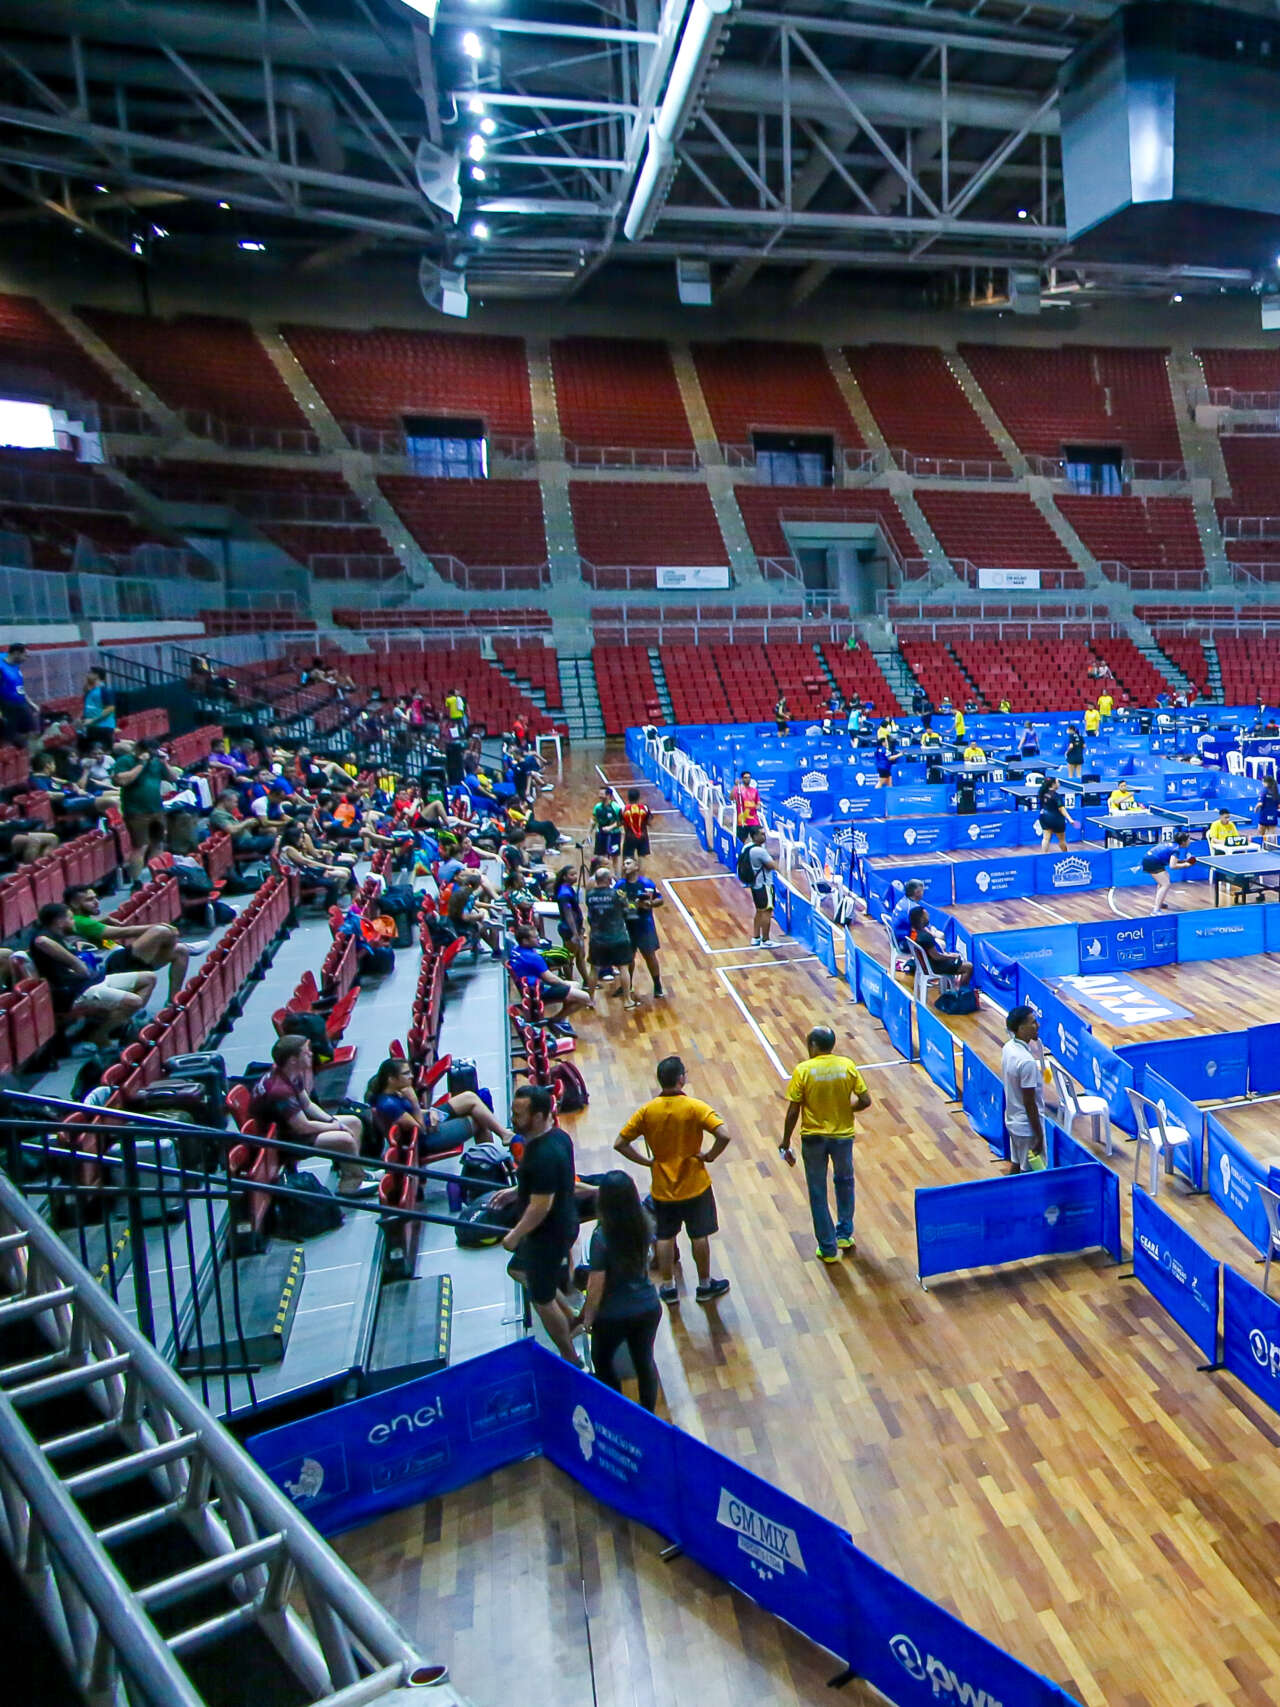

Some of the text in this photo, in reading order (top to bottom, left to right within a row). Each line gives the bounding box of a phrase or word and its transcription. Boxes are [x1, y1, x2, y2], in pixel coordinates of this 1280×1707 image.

[1162, 831, 1173, 842] 13
[1116, 927, 1145, 942] enel
[367, 1395, 444, 1445] enel
[728, 1500, 792, 1559] GM MIX
